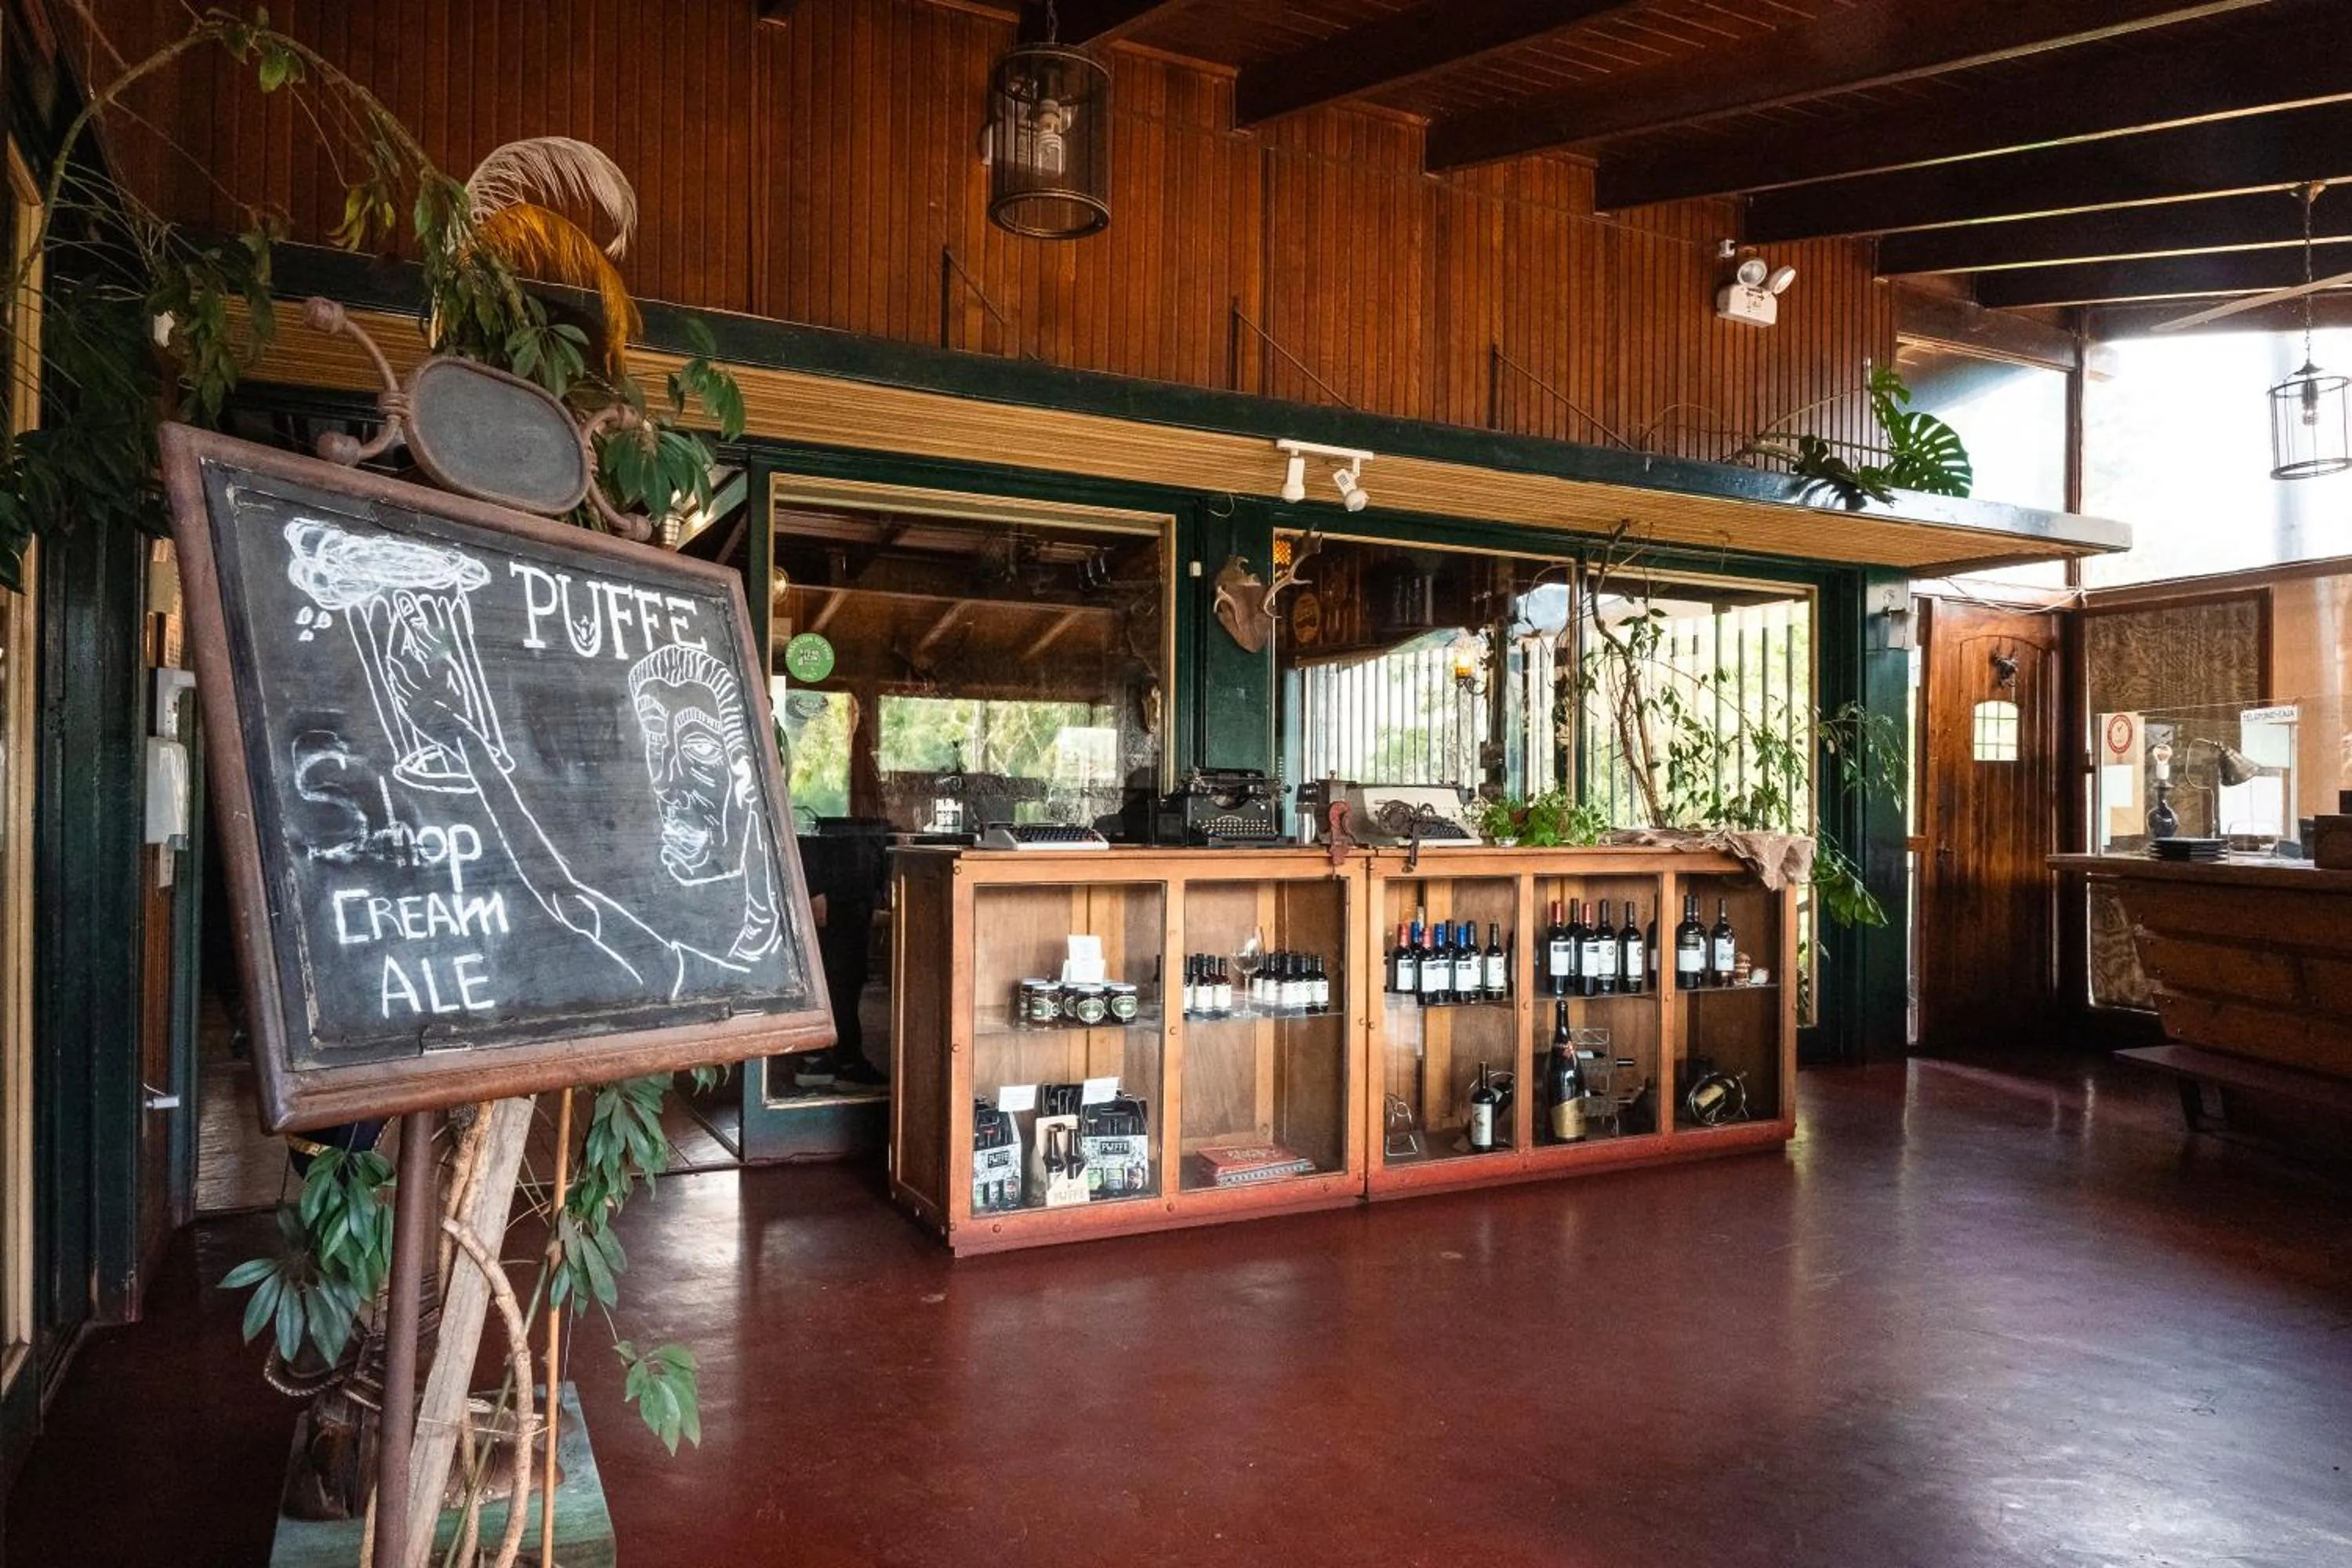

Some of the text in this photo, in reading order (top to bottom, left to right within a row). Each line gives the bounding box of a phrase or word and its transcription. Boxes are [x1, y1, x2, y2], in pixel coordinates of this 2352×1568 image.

[509, 561, 709, 660] PUFFE
[332, 888, 510, 944] CREAM
[381, 953, 495, 1018] ALE
